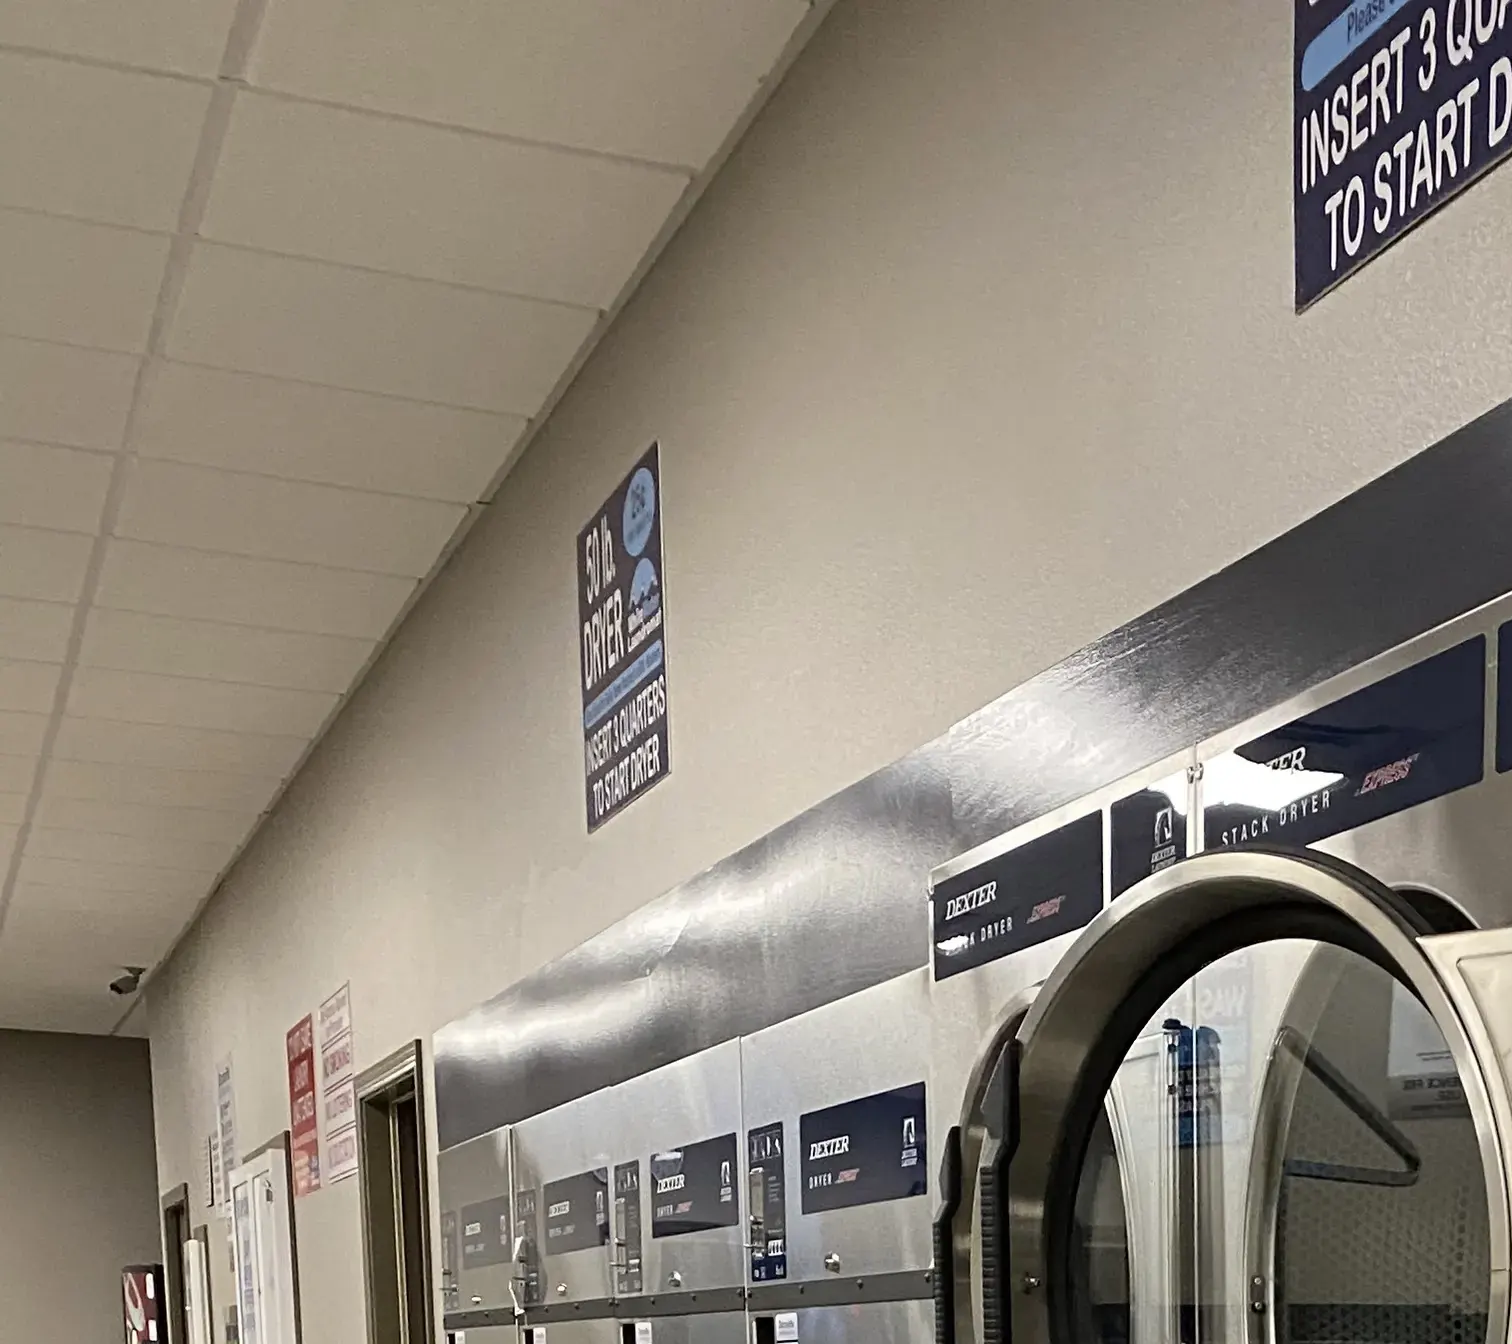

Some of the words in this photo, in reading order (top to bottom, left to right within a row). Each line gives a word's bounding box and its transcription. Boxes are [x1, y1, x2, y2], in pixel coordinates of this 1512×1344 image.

[1302, 27, 1411, 194] INSERT
[1418, 7, 1437, 91] 3
[1325, 175, 1366, 271] TO
[1374, 78, 1480, 234] START
[586, 527, 600, 604] 50
[583, 588, 625, 690] DRYER
[586, 720, 612, 776] INSERT
[613, 715, 619, 753] 3
[620, 674, 666, 748] QUARTERS
[593, 779, 604, 820] TO
[604, 759, 630, 811] START
[630, 733, 660, 791] DRYER
[1222, 815, 1269, 846] STACK
[1279, 790, 1331, 827] DRYER
[945, 880, 997, 921] DEXTER
[980, 916, 1013, 943] DRYER
[809, 1135, 850, 1161] DEXTER
[809, 1172, 832, 1190] DRYER
